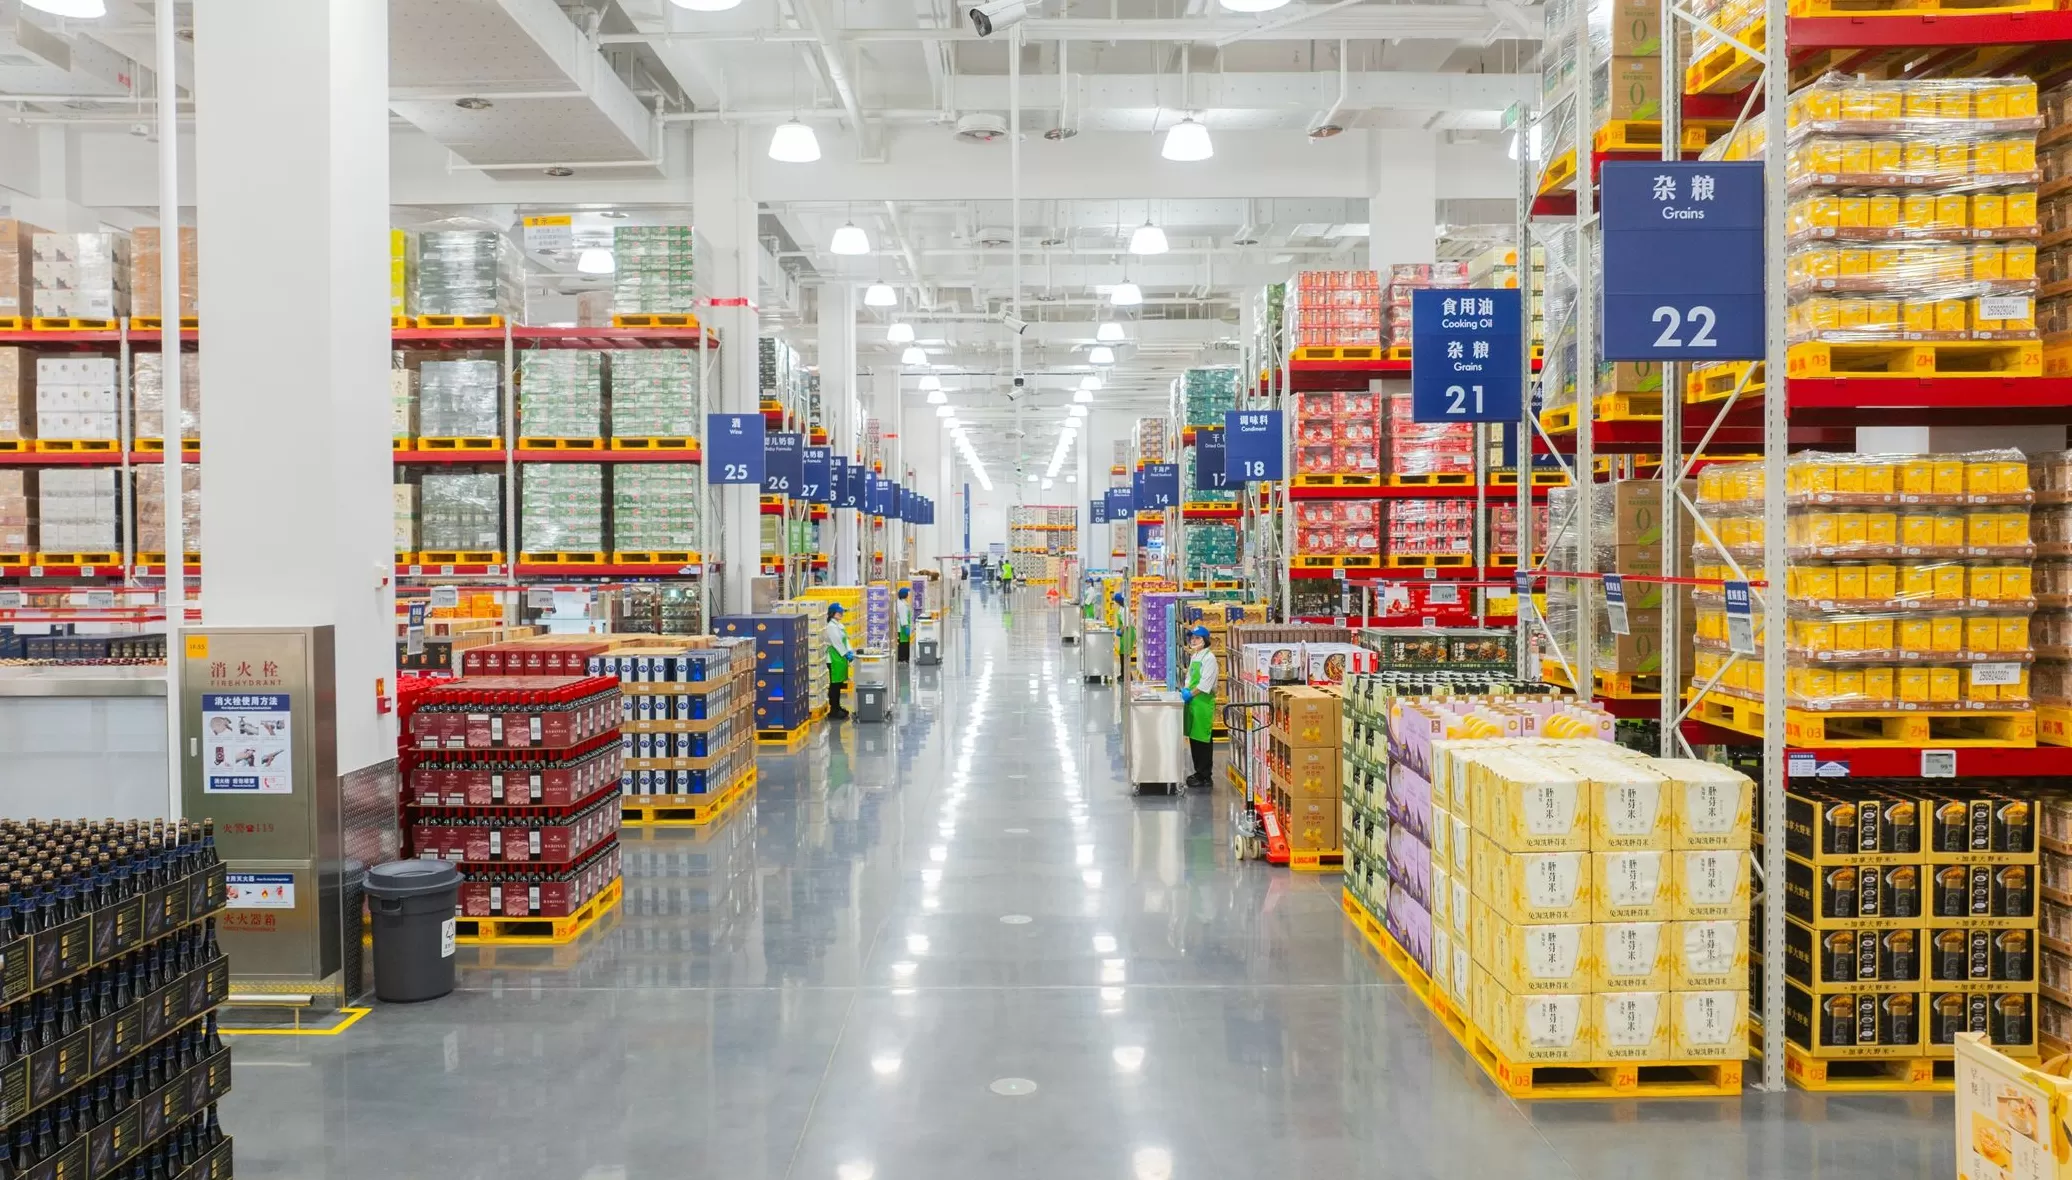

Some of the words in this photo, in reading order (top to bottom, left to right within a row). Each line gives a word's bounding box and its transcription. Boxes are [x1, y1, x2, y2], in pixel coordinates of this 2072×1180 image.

[1652, 174, 1715, 201] 杂粮
[1662, 206, 1705, 220] Grains
[1442, 297, 1494, 316] 食用油
[1442, 318, 1477, 330] Cooking
[1479, 318, 1493, 328] Oil
[1651, 305, 1718, 348] 22
[1447, 340, 1490, 359] 杂粮
[1916, 355, 1933, 366] ZH
[2024, 354, 2040, 365] 25
[1453, 362, 1482, 372] Grains
[1445, 385, 1484, 414] 21
[1240, 415, 1268, 426] 调味料
[724, 464, 748, 480] 25
[1244, 461, 1265, 477] 18
[768, 476, 789, 490] 26
[801, 484, 818, 497] 27
[1155, 494, 1169, 504] 14
[1117, 509, 1128, 517] 10
[210, 661, 279, 678] 消火栓
[214, 696, 278, 706] 消火栓使用方法
[1806, 727, 1821, 738] 03
[1910, 725, 1928, 738] ZH
[2018, 725, 2033, 738] 25
[256, 823, 274, 833] 119
[1293, 855, 1318, 865] LOSCAM
[1850, 856, 1891, 864] 加拿大野米
[1962, 855, 2004, 863] 加拿大野米
[1962, 919, 2004, 927] 加拿大野米
[1961, 983, 2004, 991] 加拿大野米
[1515, 1075, 1530, 1086] 03
[1618, 1074, 1636, 1086] ZH
[1724, 1073, 1740, 1084] 25
[1810, 1068, 1824, 1080] 03
[1912, 1069, 1931, 1081] ZH
